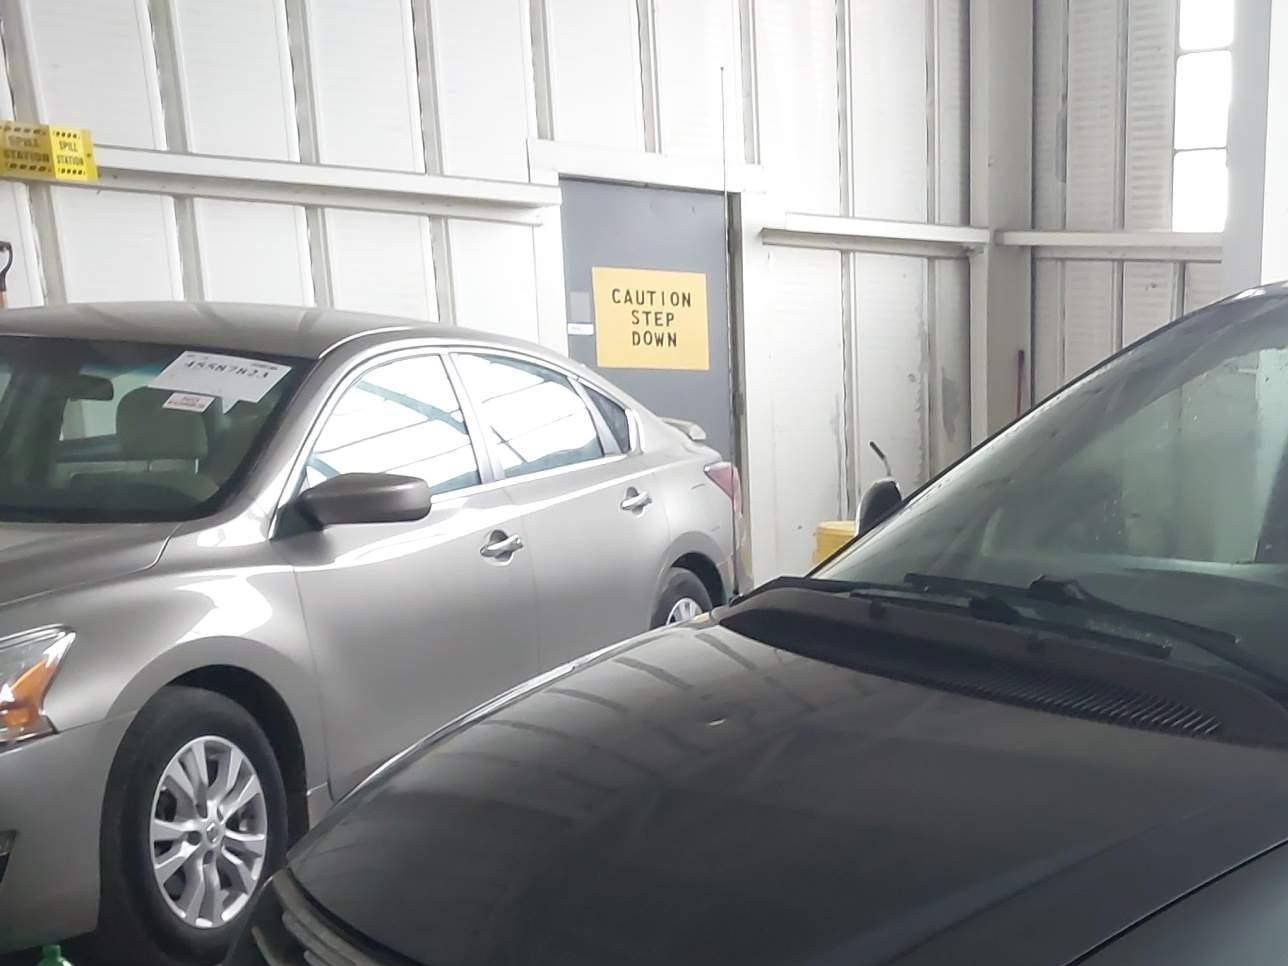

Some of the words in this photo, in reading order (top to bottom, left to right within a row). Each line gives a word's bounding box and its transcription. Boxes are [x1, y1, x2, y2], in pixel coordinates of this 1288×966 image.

[59, 140, 79, 153] SPILL
[56, 154, 84, 166] STATION
[611, 287, 692, 308] CAUTION
[631, 308, 675, 328] STEP
[631, 329, 678, 348] DOWN
